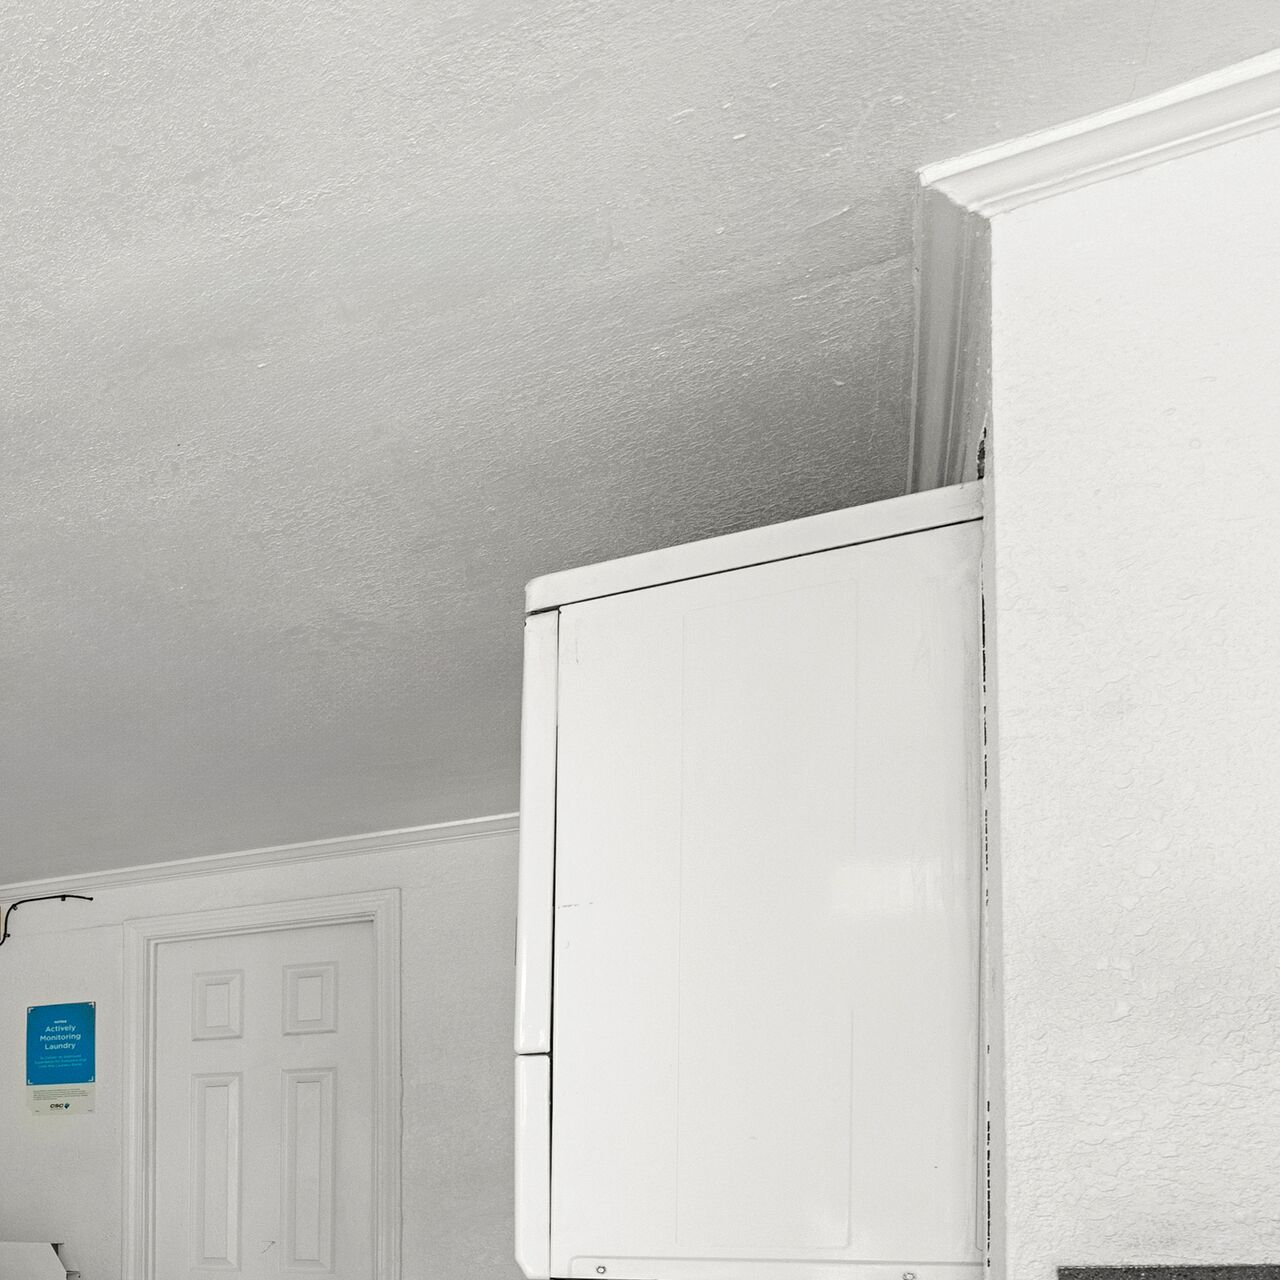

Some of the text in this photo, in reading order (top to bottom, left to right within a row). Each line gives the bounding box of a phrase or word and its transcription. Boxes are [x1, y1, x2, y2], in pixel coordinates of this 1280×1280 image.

[45, 1024, 76, 1032] Actively
[40, 1033, 81, 1041] Monitoring
[44, 1042, 76, 1050] Laundry
